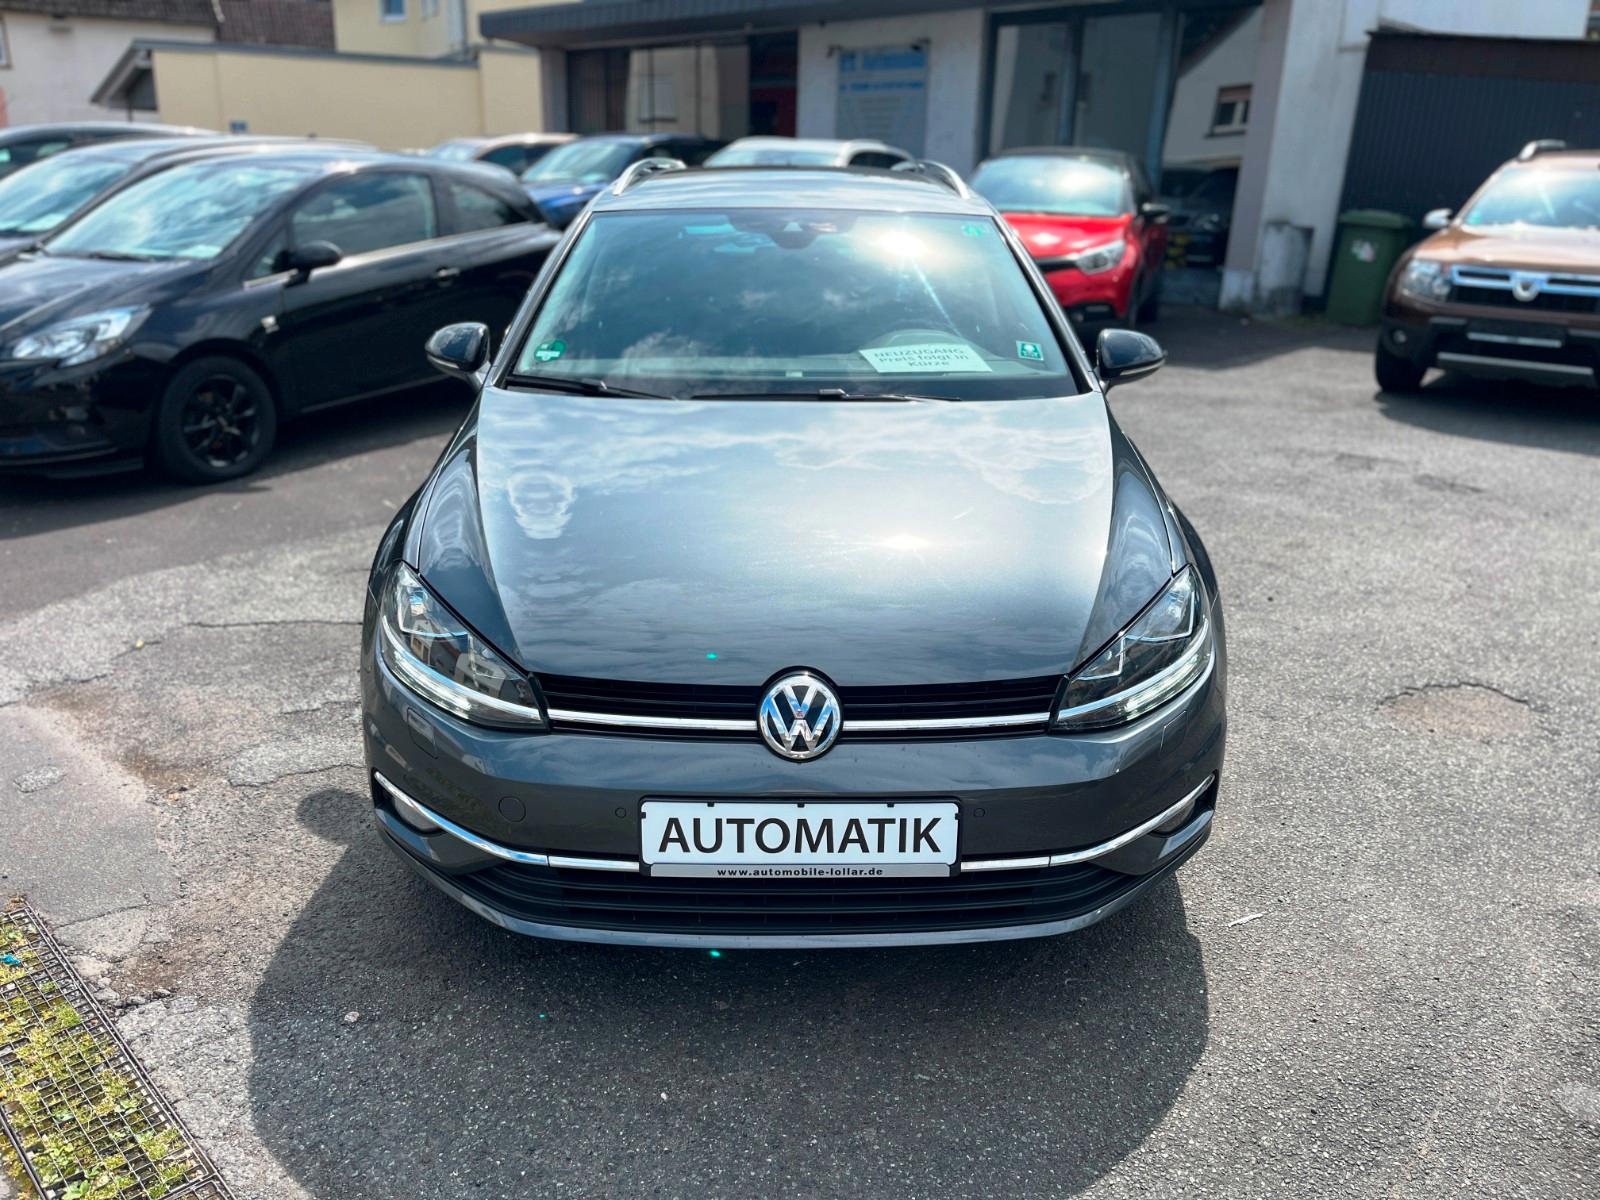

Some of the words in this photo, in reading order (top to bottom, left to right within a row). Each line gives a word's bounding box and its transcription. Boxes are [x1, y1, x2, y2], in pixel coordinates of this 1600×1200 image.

[763, 677, 838, 756] VW
[658, 817, 942, 854] AUTOMATIK
[716, 868, 883, 877] www.automobile-lollar.de
